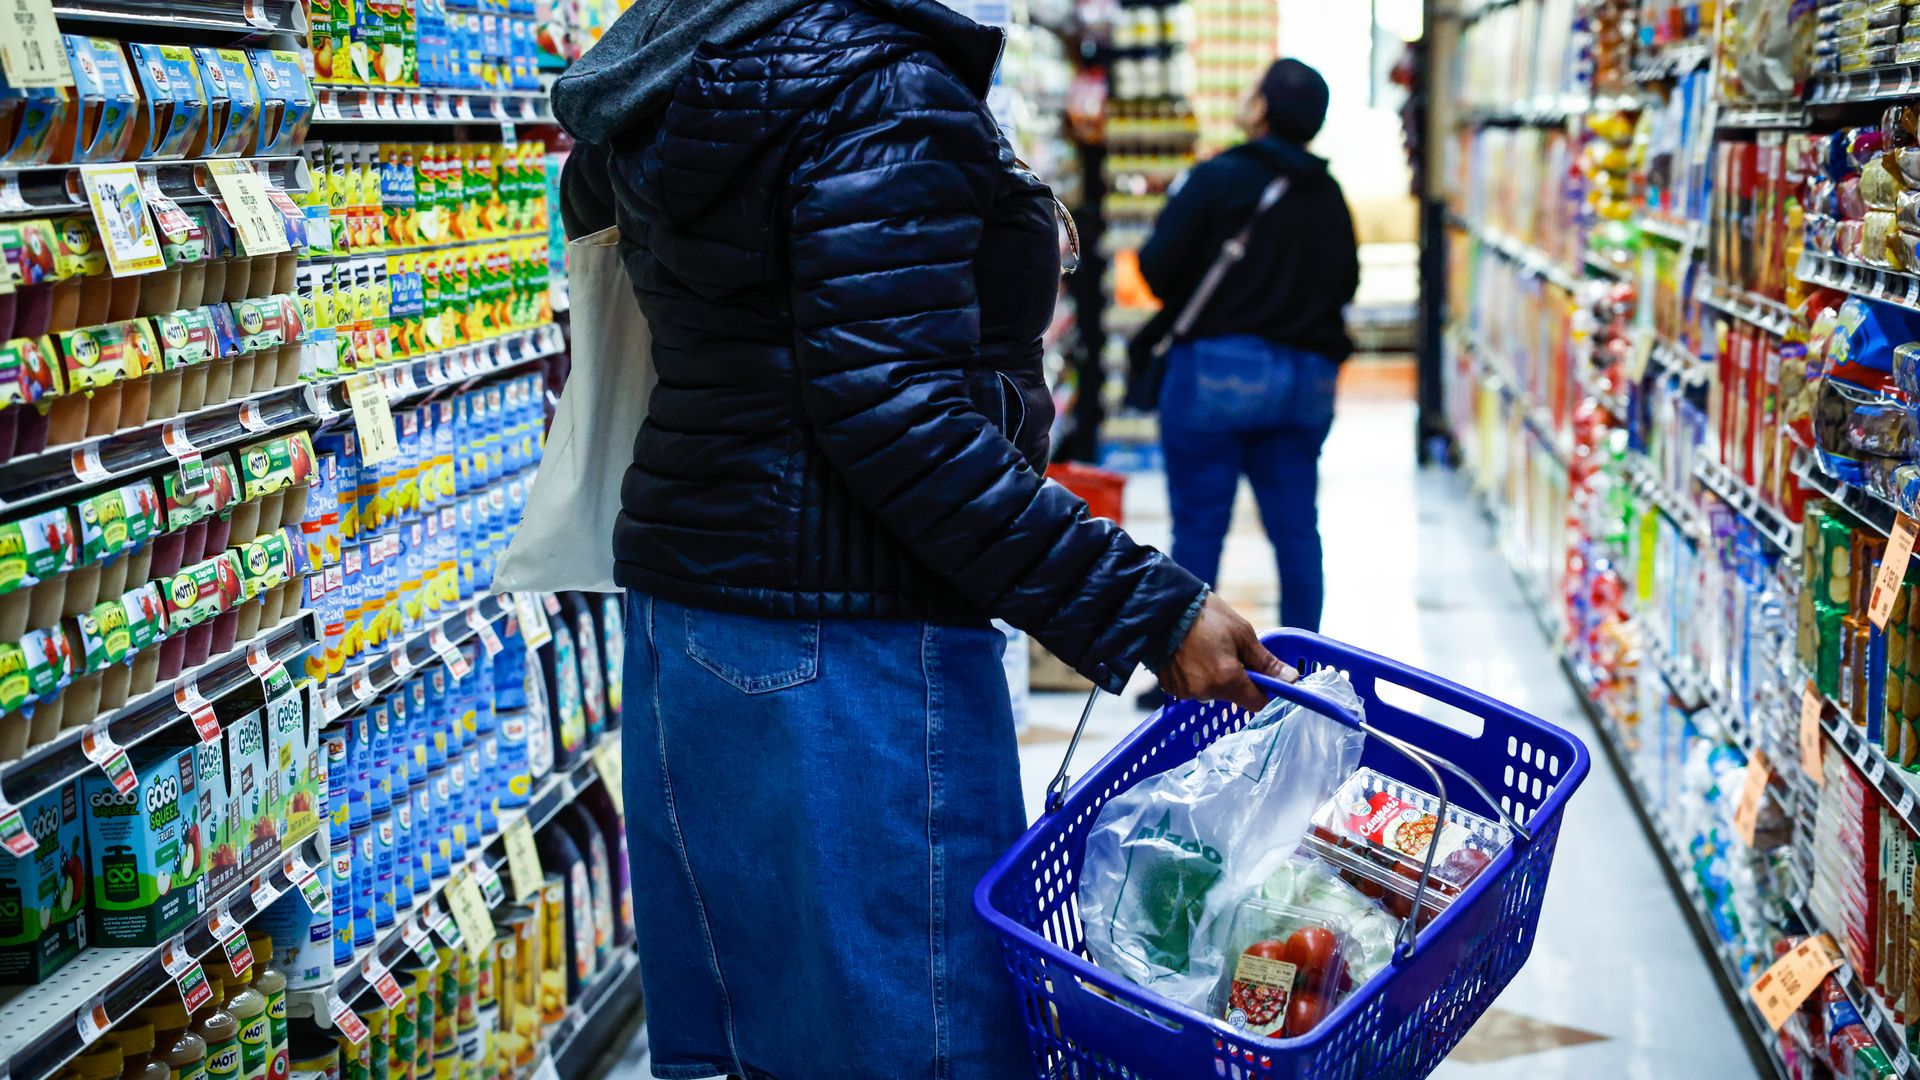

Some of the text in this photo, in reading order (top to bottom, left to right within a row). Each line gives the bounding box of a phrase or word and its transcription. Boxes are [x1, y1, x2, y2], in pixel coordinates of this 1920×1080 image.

[242, 312, 262, 327] MOTT'S
[167, 322, 187, 340] MOTT'S
[250, 454, 269, 472] MOTT'S
[250, 551, 268, 570] MOTT'S
[174, 580, 196, 601] MOTT'S
[239, 720, 258, 755] GoGo
[182, 775, 193, 789] FRUIT
[89, 791, 138, 807] GOGO
[146, 775, 178, 813] GOGO
[92, 806, 138, 818] SQUEEZ
[150, 801, 180, 831] SQUEEZ
[1359, 796, 1399, 837] Campari
[1906, 849, 1916, 898] Maria
